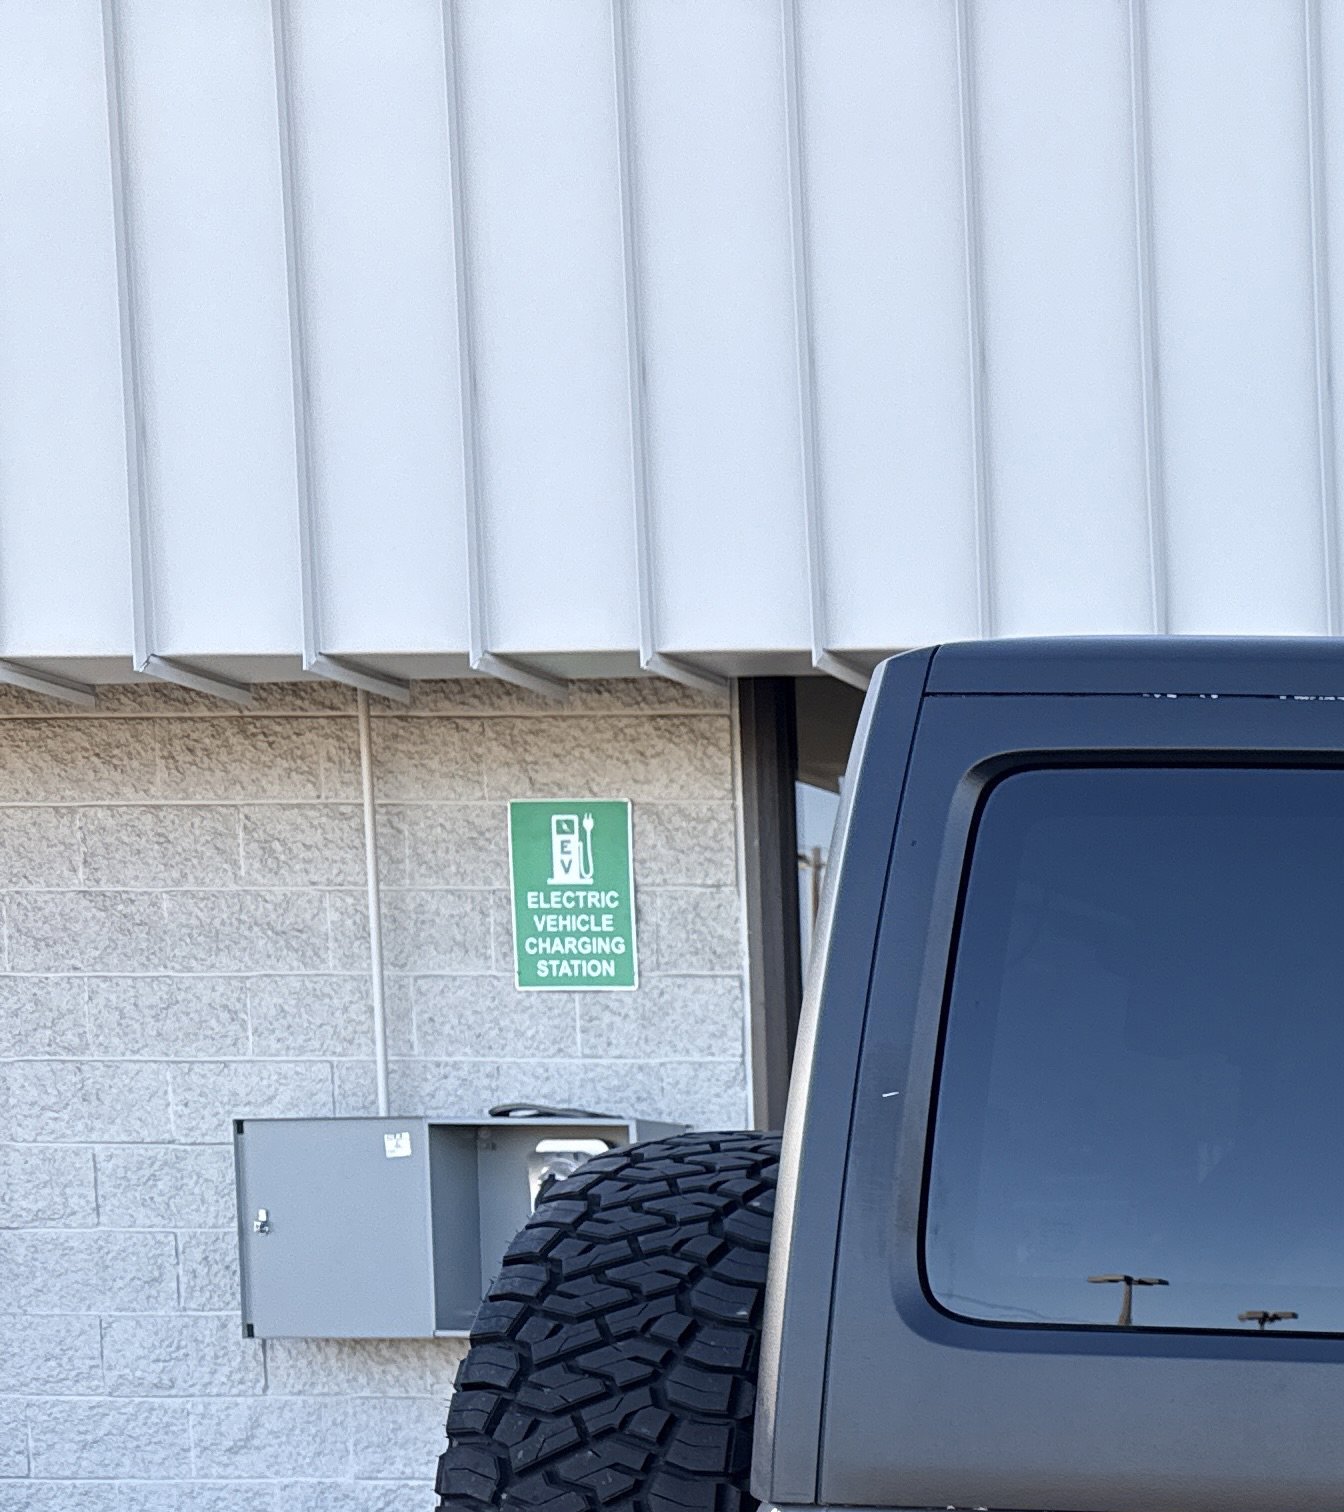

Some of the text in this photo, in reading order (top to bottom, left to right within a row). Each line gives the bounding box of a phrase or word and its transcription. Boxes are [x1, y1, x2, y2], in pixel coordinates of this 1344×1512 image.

[560, 839, 573, 875] EV
[527, 891, 620, 910] ELECTRIC
[533, 914, 615, 932] VEHICLE
[525, 936, 626, 955] CHARGING
[536, 959, 616, 977] STATION
